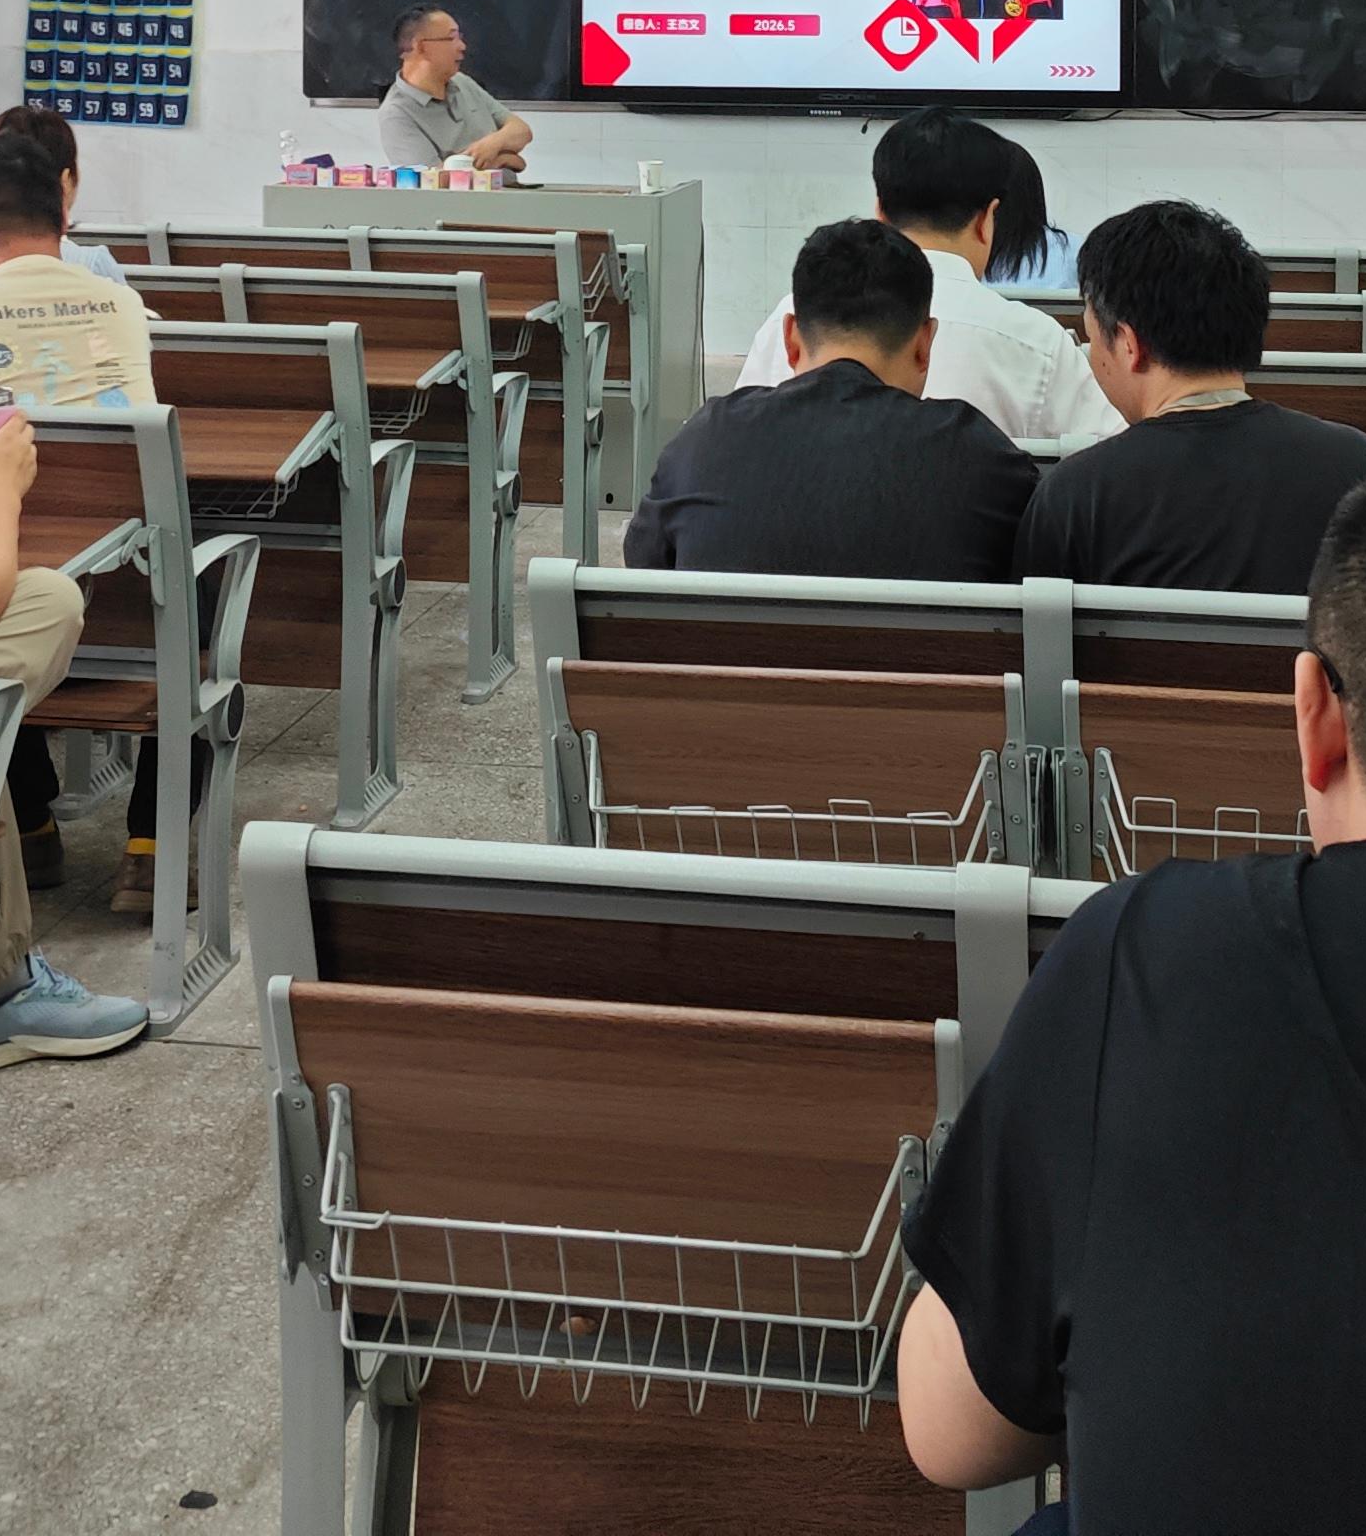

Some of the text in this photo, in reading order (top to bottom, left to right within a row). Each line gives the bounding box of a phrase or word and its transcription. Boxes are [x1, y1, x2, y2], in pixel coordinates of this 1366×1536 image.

[34, 19, 184, 39] 43 44 45 46 47 48
[754, 20, 795, 31] 2026.5
[30, 60, 182, 78] 49 50 51 52 53 54
[58, 99, 72, 113] 56
[85, 101, 100, 114] 57
[111, 102, 127, 116] 58
[139, 103, 154, 117] 59
[54, 299, 117, 317] Market
